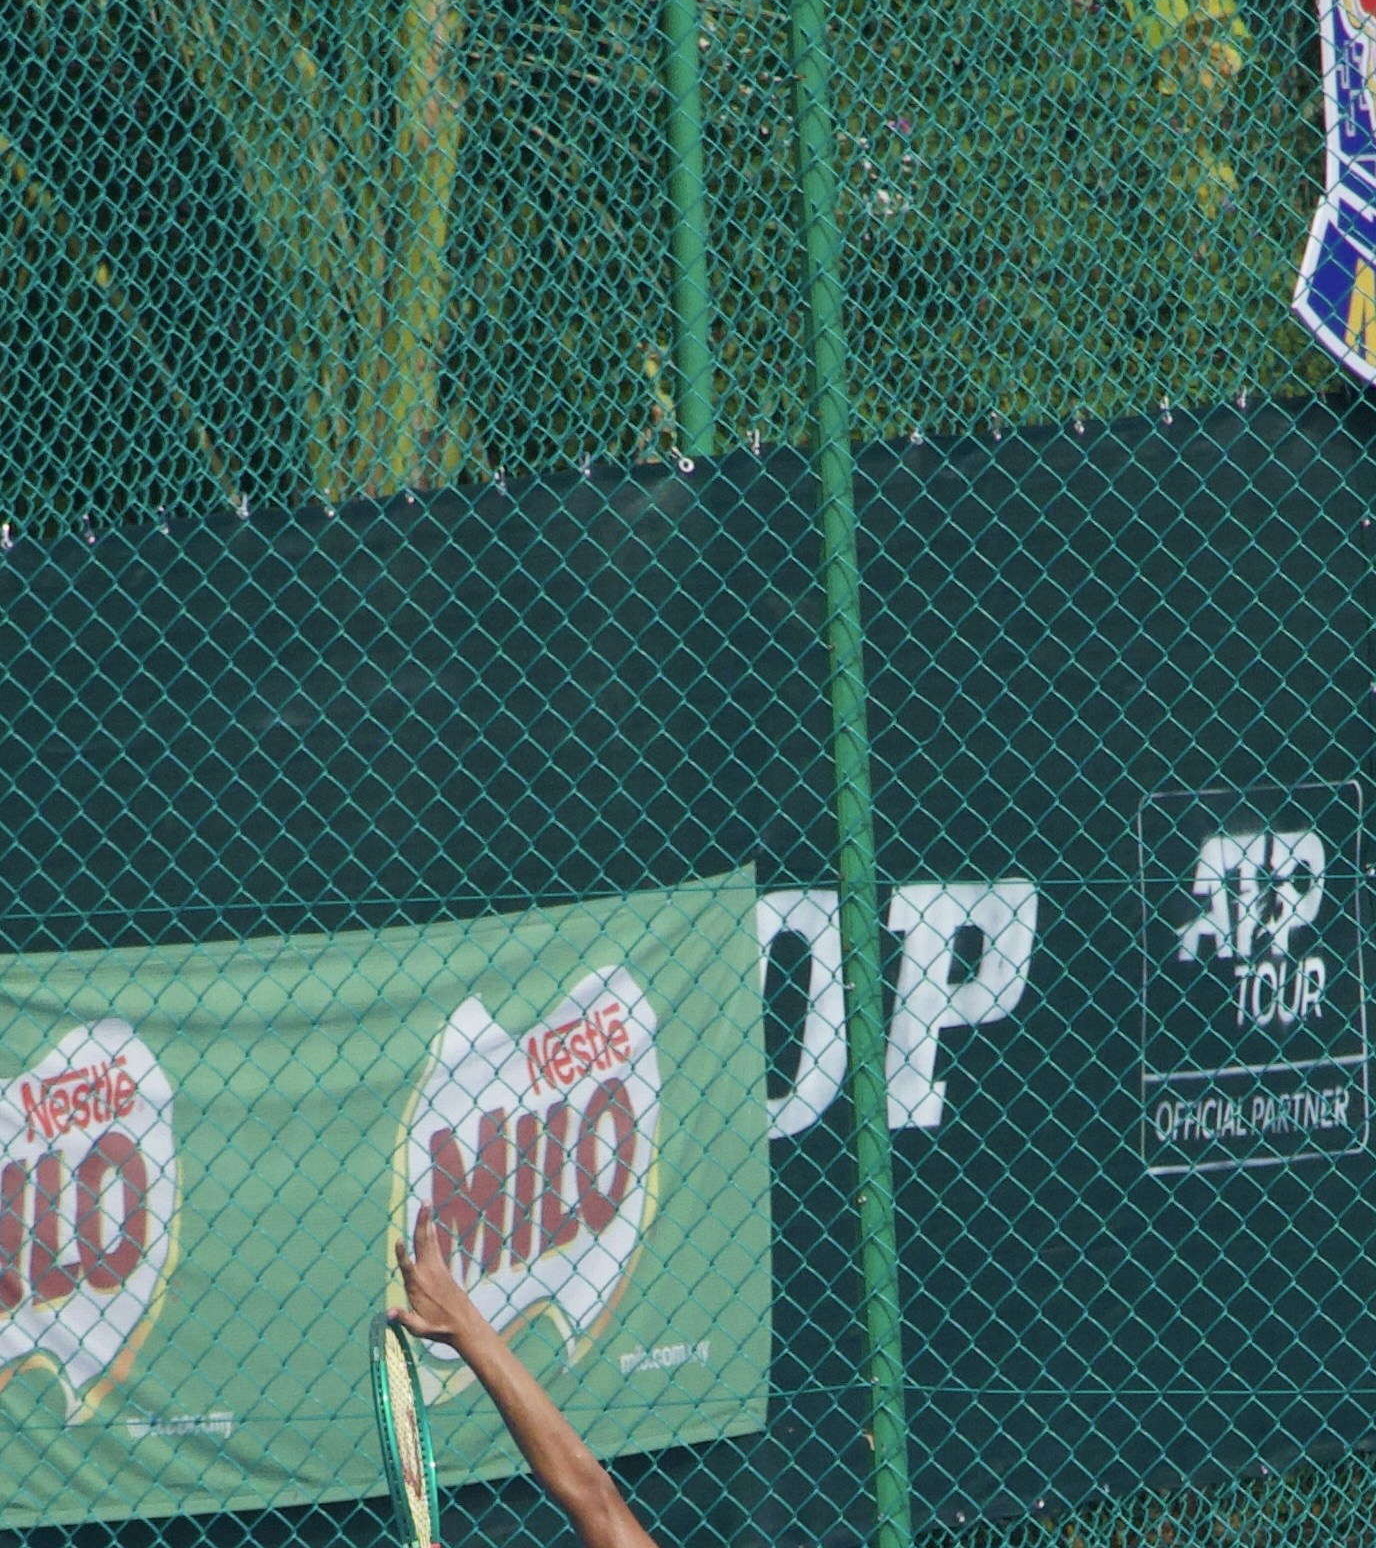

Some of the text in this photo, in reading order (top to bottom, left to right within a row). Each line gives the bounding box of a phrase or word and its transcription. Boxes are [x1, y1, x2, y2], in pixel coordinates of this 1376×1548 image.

[1176, 830, 1326, 962] ATP
[1233, 956, 1325, 1029] TOUR
[1155, 1085, 1351, 1142] OFFICIAL PARTNER
[428, 1076, 638, 1288] MILO
